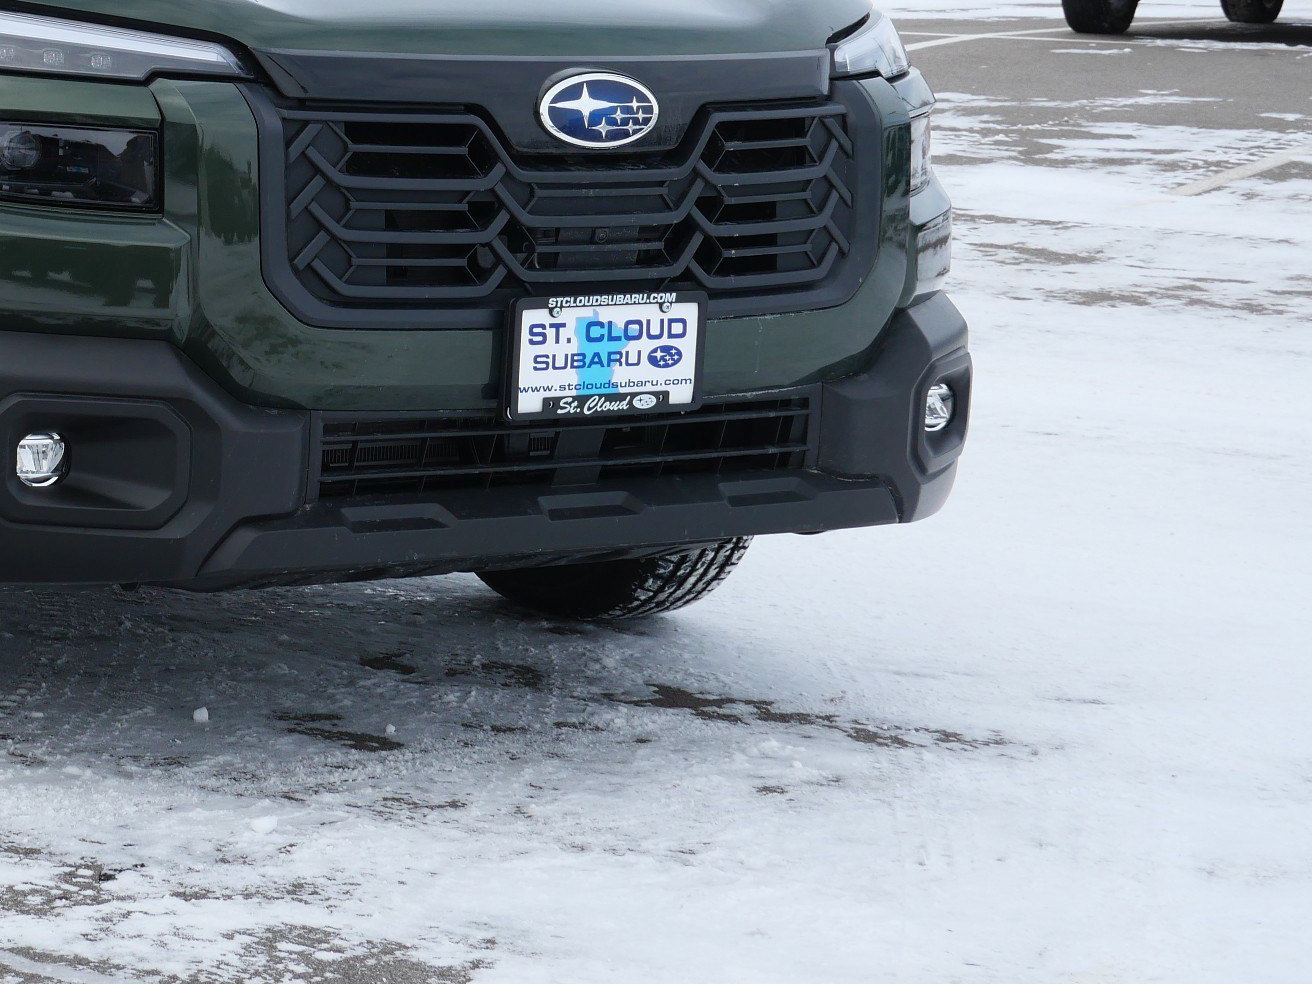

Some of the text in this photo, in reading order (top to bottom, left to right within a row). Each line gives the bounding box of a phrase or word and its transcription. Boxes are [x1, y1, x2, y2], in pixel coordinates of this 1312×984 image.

[548, 293, 677, 308] STCLOUDSUBARU.COM
[528, 317, 687, 346] ST. CLOUD
[532, 349, 642, 372] SUBARU
[518, 377, 693, 394] www.stcloudsubaru.com
[556, 395, 631, 415] St. Cloud
